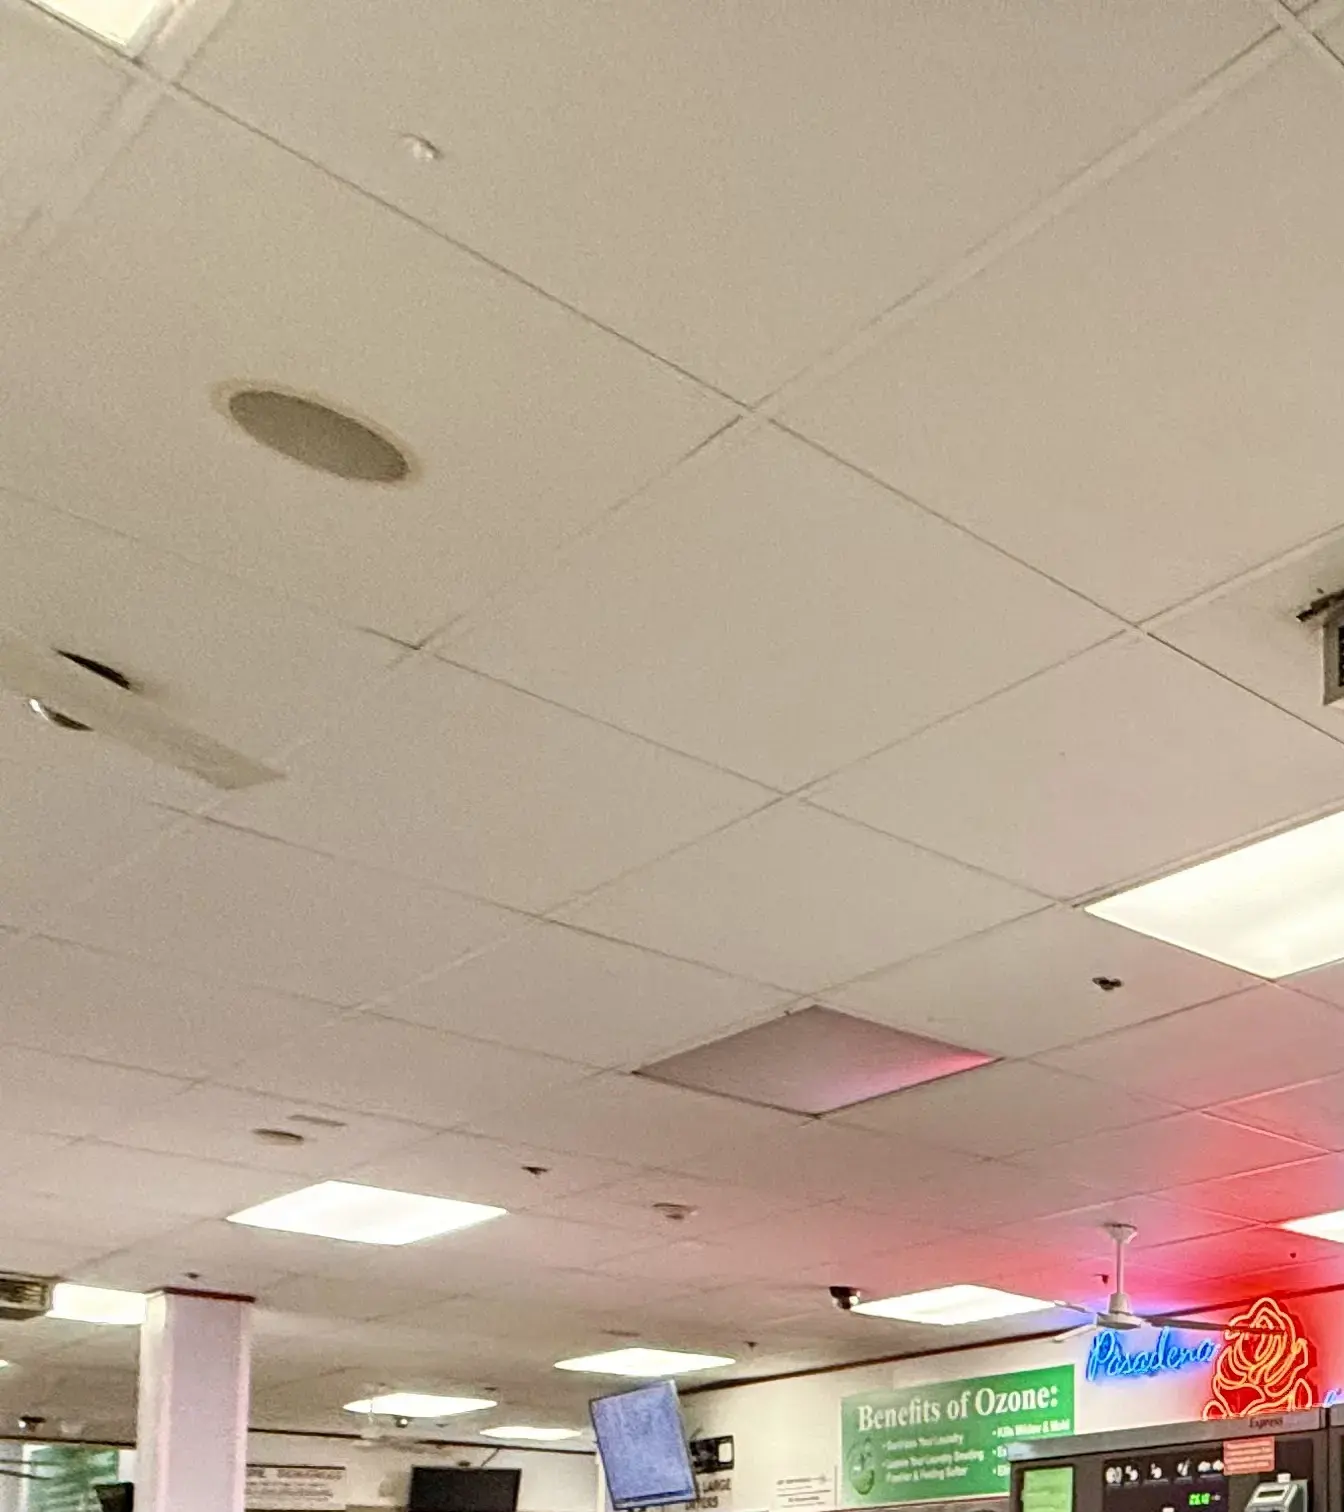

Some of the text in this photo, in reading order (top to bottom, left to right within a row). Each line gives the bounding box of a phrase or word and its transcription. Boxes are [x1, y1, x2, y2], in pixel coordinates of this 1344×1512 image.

[1086, 1326, 1215, 1382] Pasadena
[857, 1385, 1059, 1431] Benefits of Ozone:
